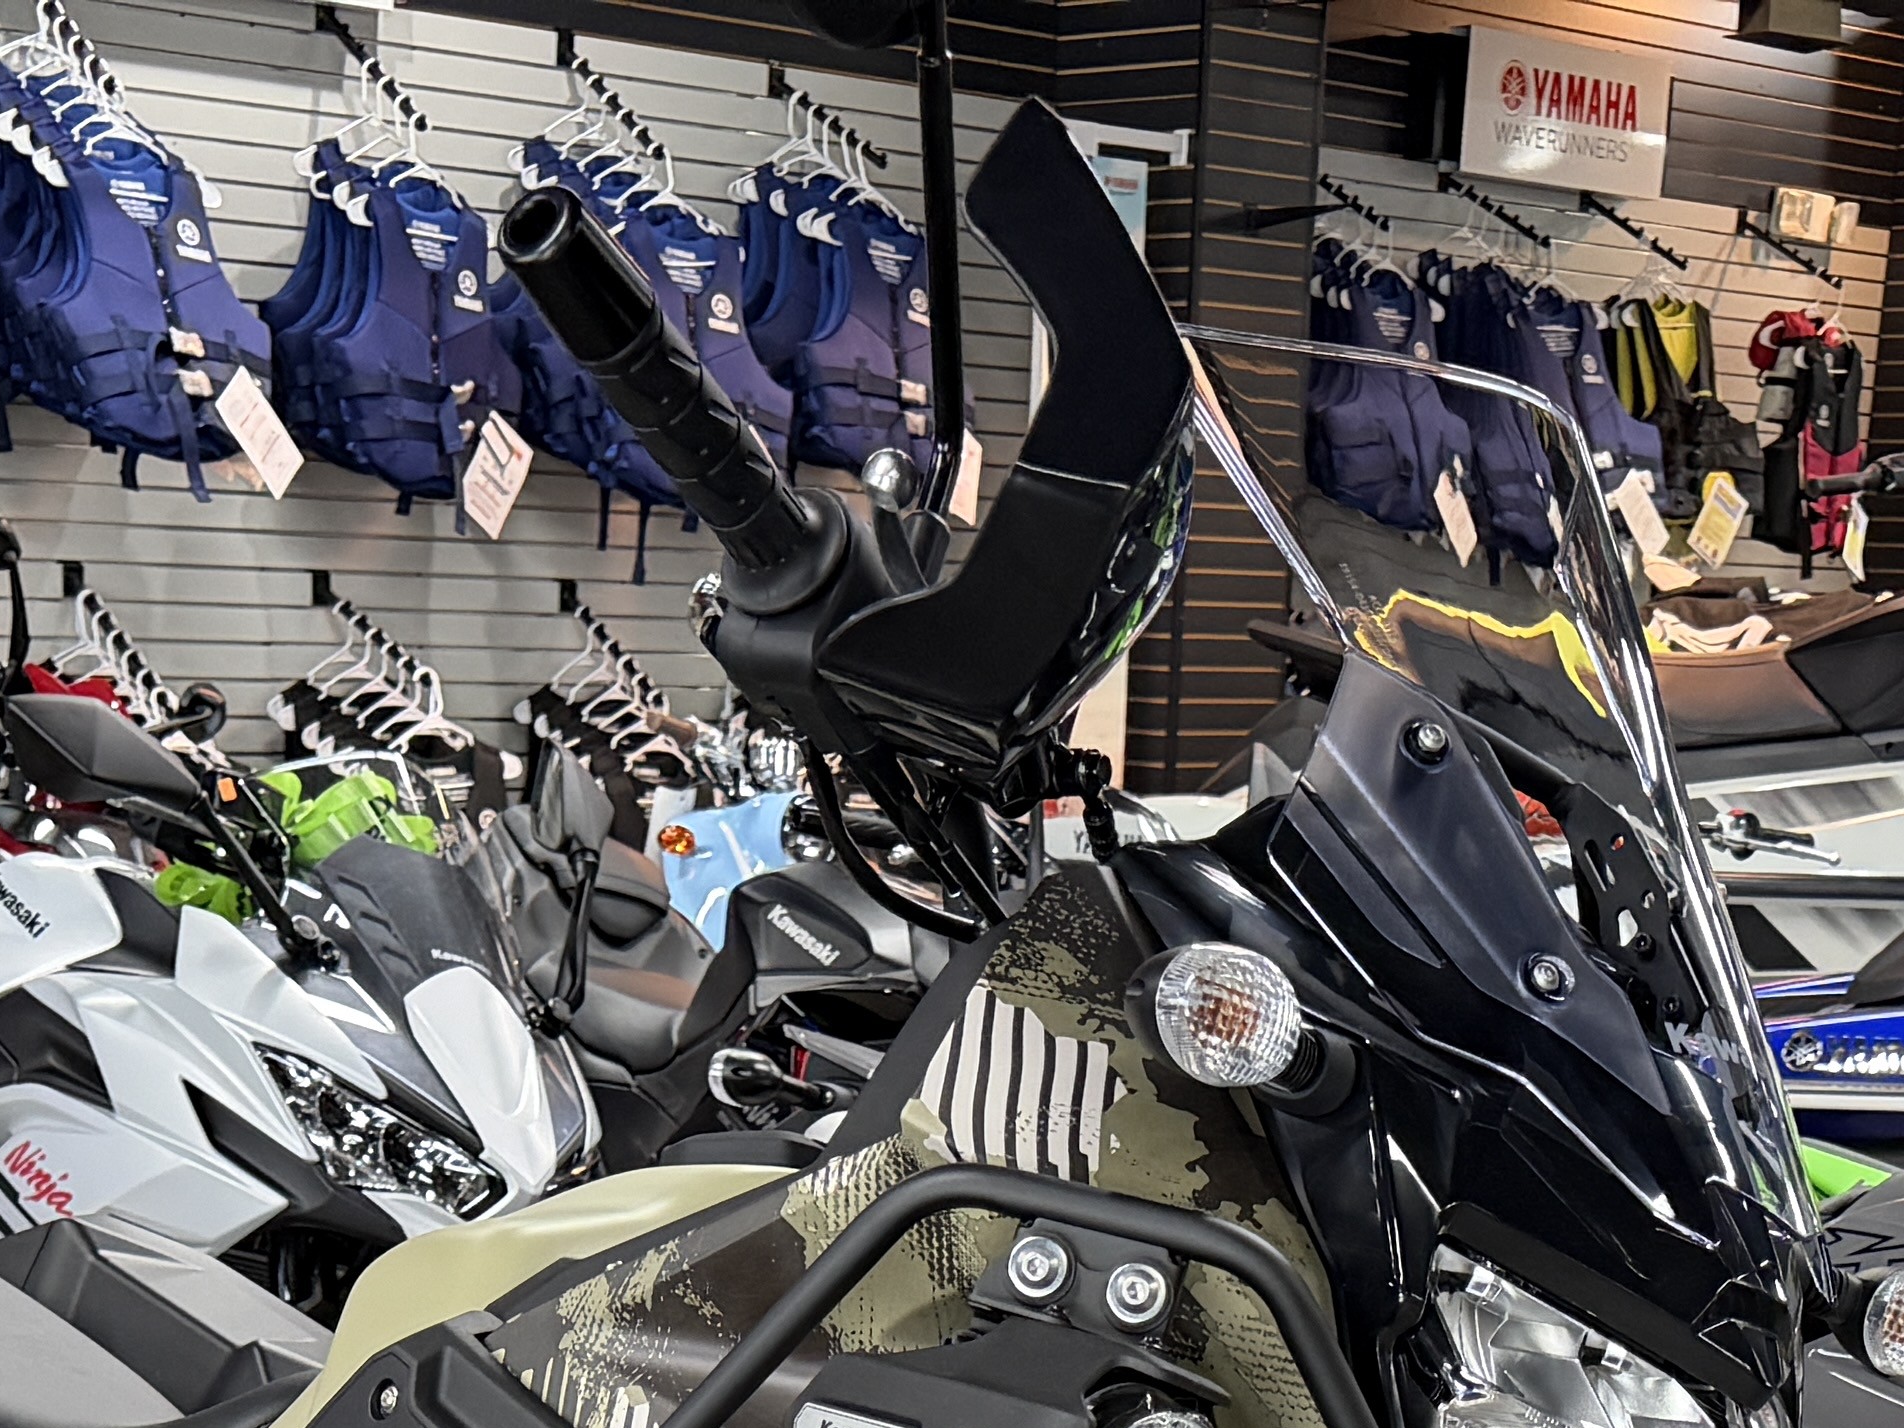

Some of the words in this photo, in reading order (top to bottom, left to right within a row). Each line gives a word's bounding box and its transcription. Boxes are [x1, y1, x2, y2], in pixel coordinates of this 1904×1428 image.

[1533, 68, 1637, 132] YAMAHA
[1493, 121, 1628, 163] WAVERUNNERS
[767, 904, 841, 967] Kawasaki
[4, 1141, 73, 1217] Ninja
